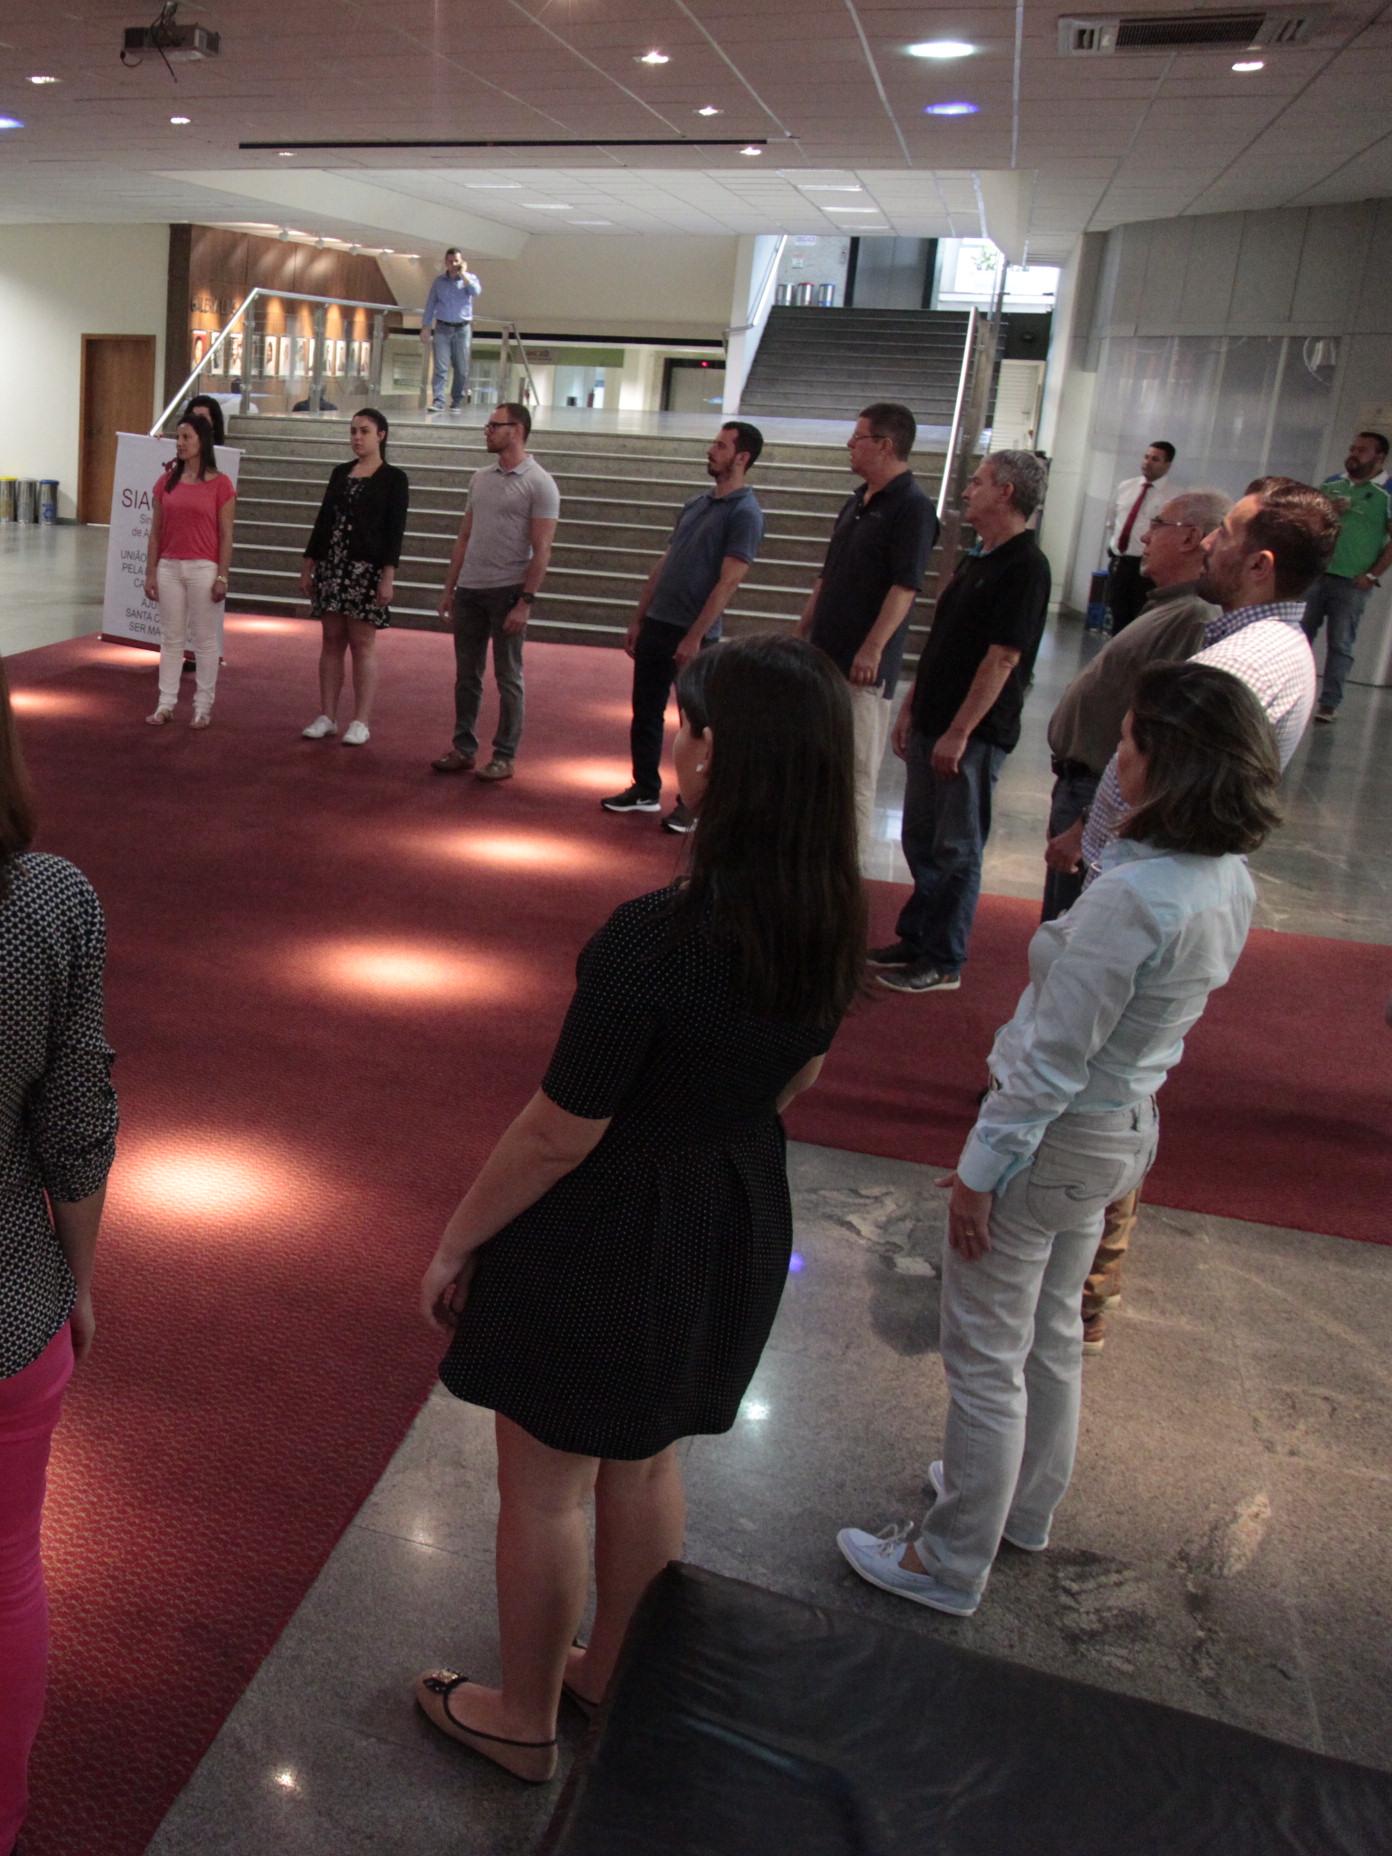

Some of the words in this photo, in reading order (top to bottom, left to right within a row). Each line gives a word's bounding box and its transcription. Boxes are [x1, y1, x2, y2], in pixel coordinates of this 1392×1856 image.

[121, 488, 153, 511] SIA
[131, 527, 142, 537] de
[120, 550, 147, 563] UNIÃO
[122, 563, 143, 575] PELA
[125, 608, 152, 621] SANTA
[128, 621, 146, 633] SER
